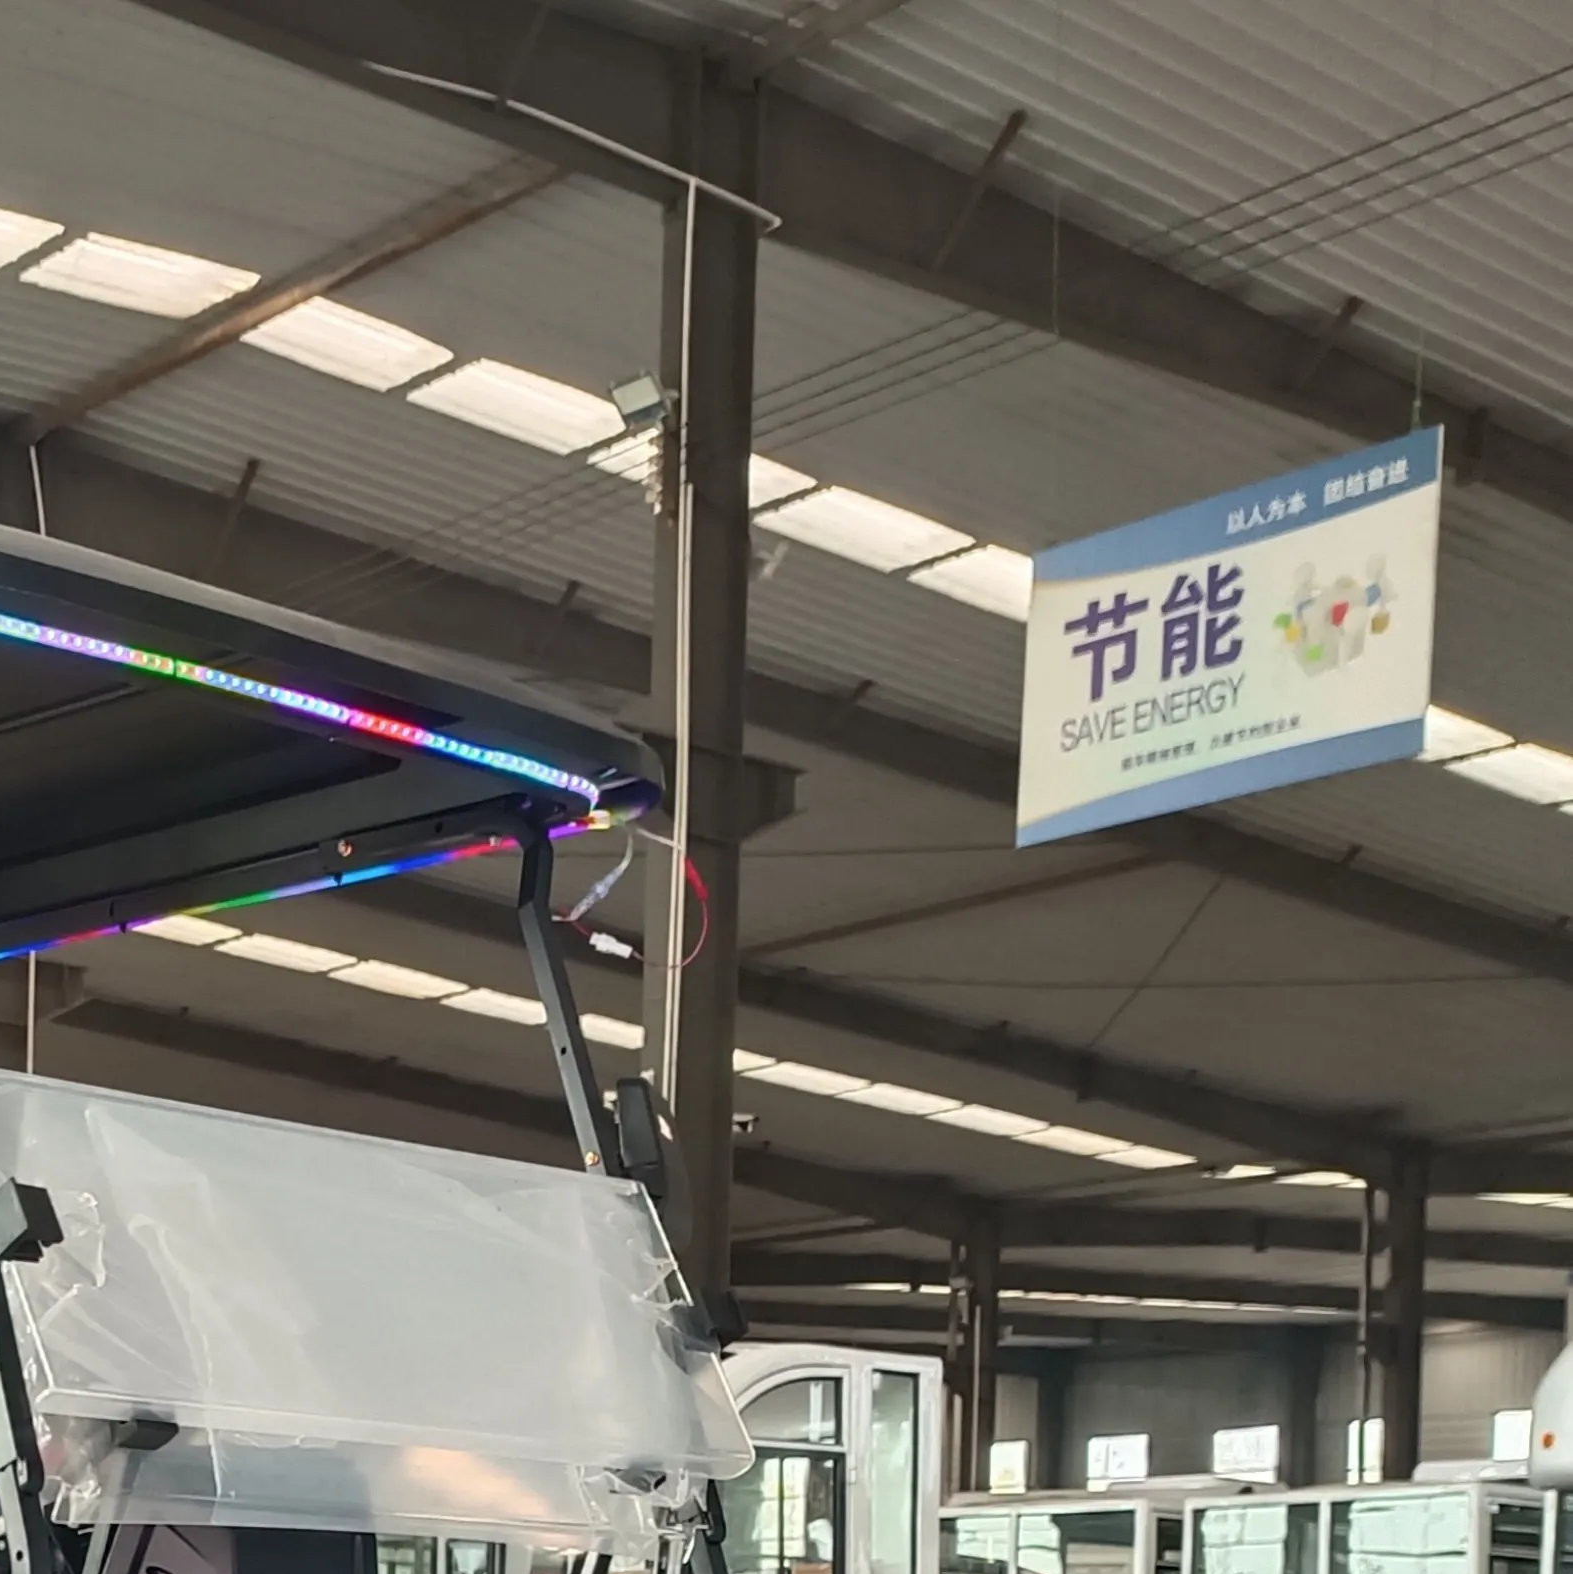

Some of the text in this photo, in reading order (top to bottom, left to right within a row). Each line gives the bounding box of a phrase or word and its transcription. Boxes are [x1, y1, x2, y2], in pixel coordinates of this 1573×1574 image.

[1064, 563, 1246, 702] 节能
[1060, 704, 1127, 753] SAVE
[1133, 670, 1246, 736] ENERGY
